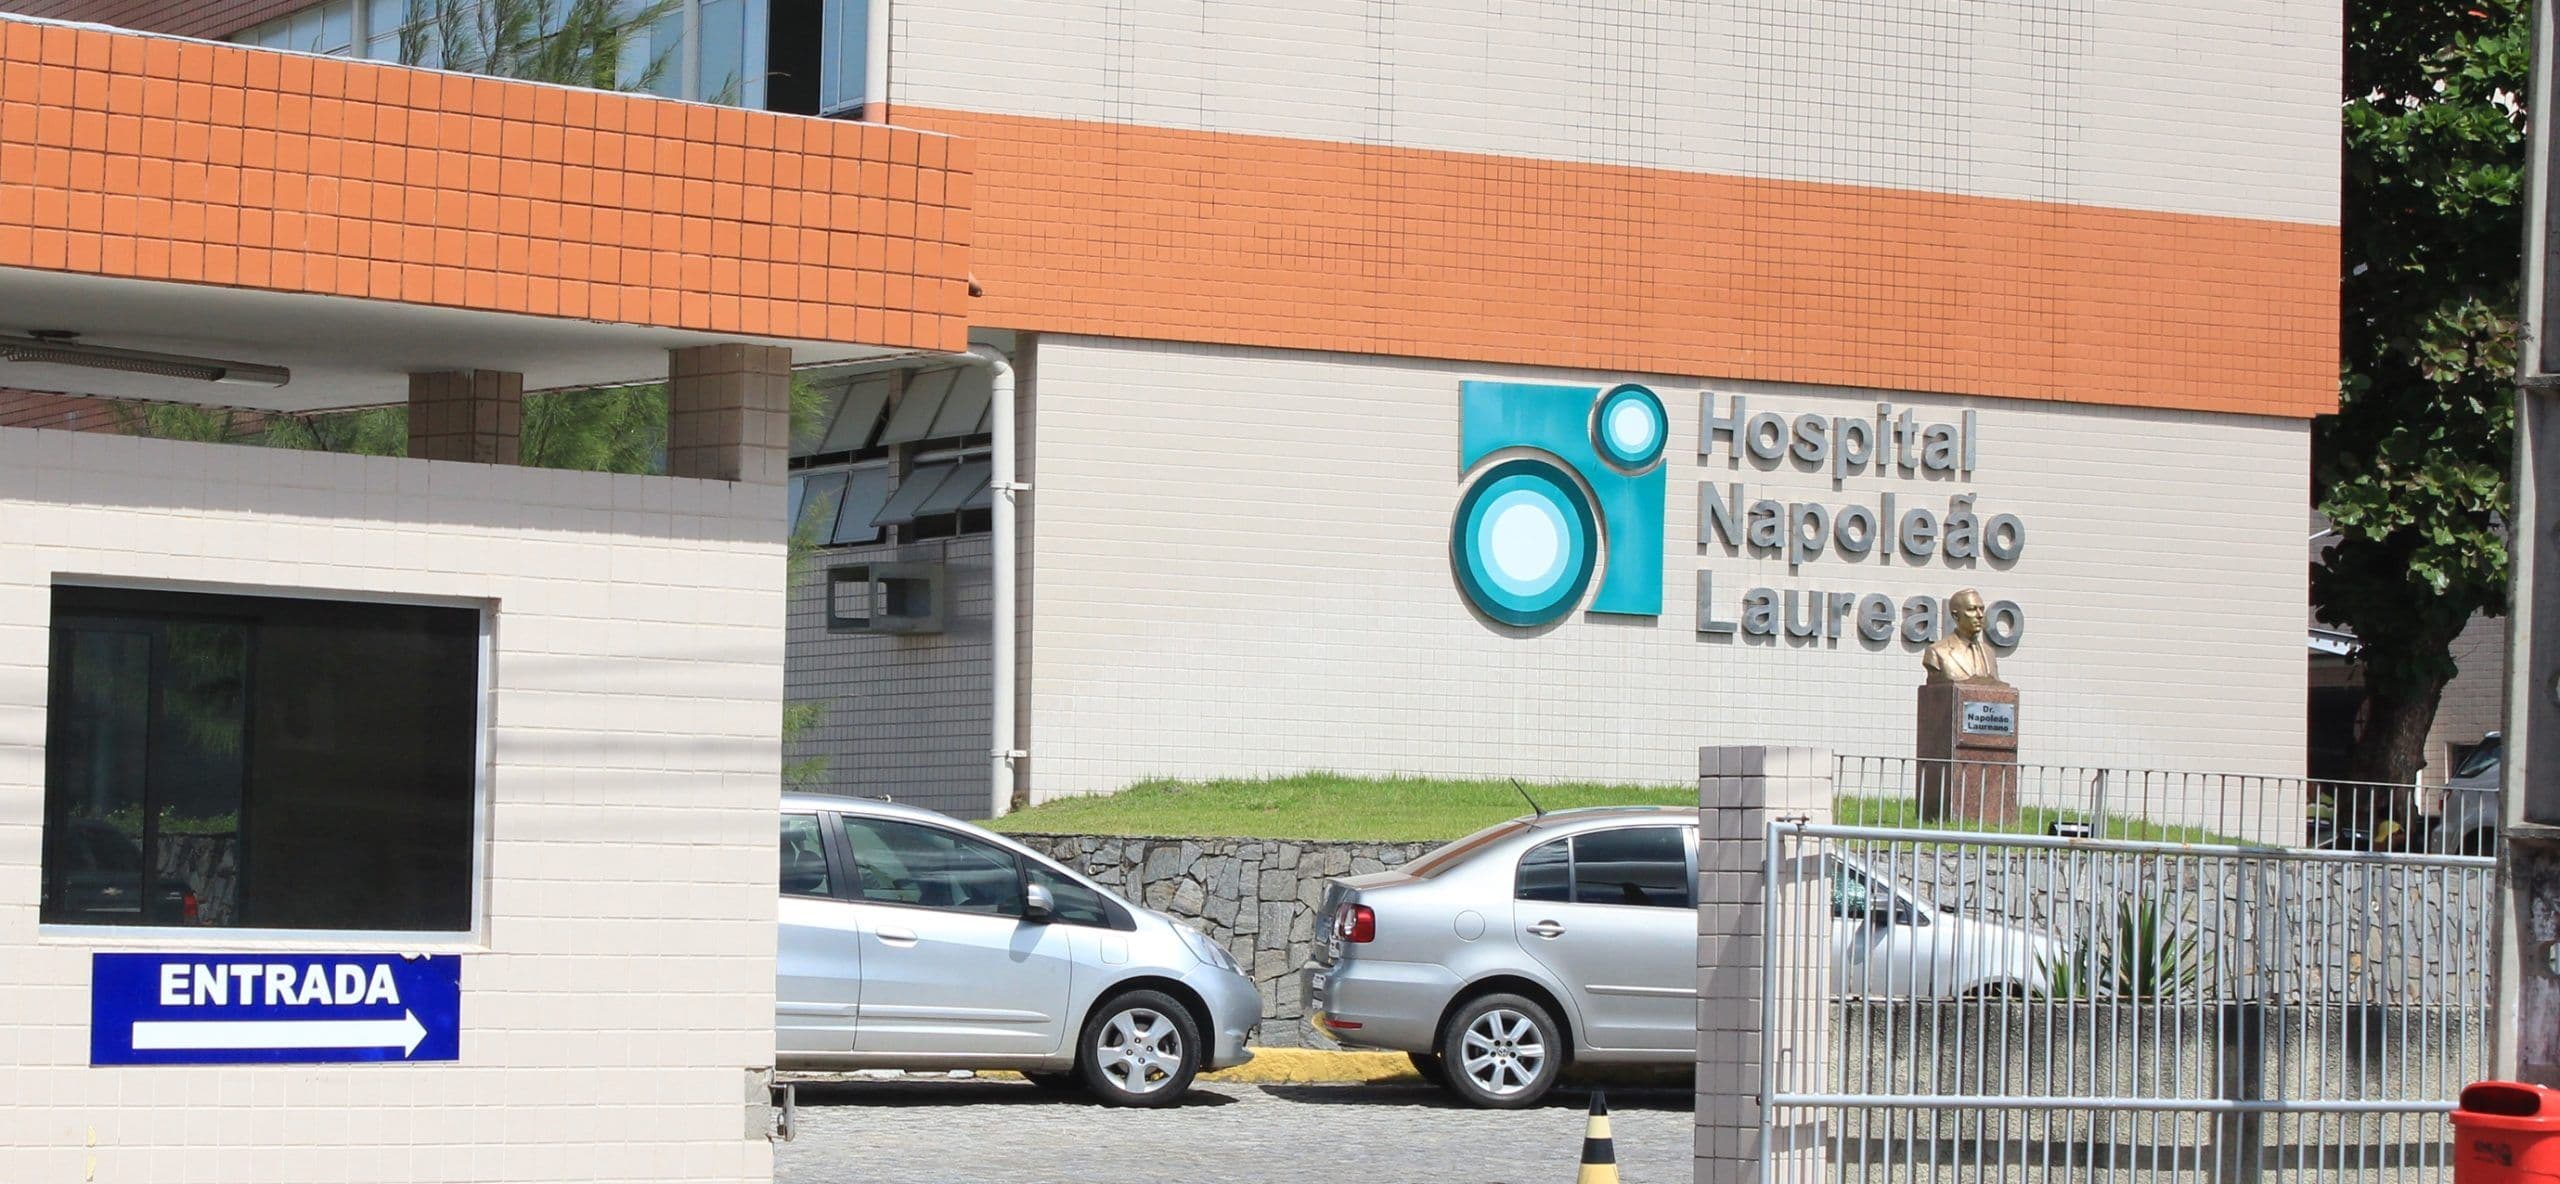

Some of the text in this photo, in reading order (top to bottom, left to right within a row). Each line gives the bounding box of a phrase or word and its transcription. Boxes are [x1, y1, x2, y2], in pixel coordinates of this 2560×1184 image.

[1698, 391, 1977, 480] Hospital
[1697, 480, 2026, 565] Napoleão
[1696, 569, 2025, 647] Laureao
[1967, 713, 2009, 724] Napoleão
[1982, 705, 1995, 714] Dr.
[160, 963, 400, 1006] ENTRADA
